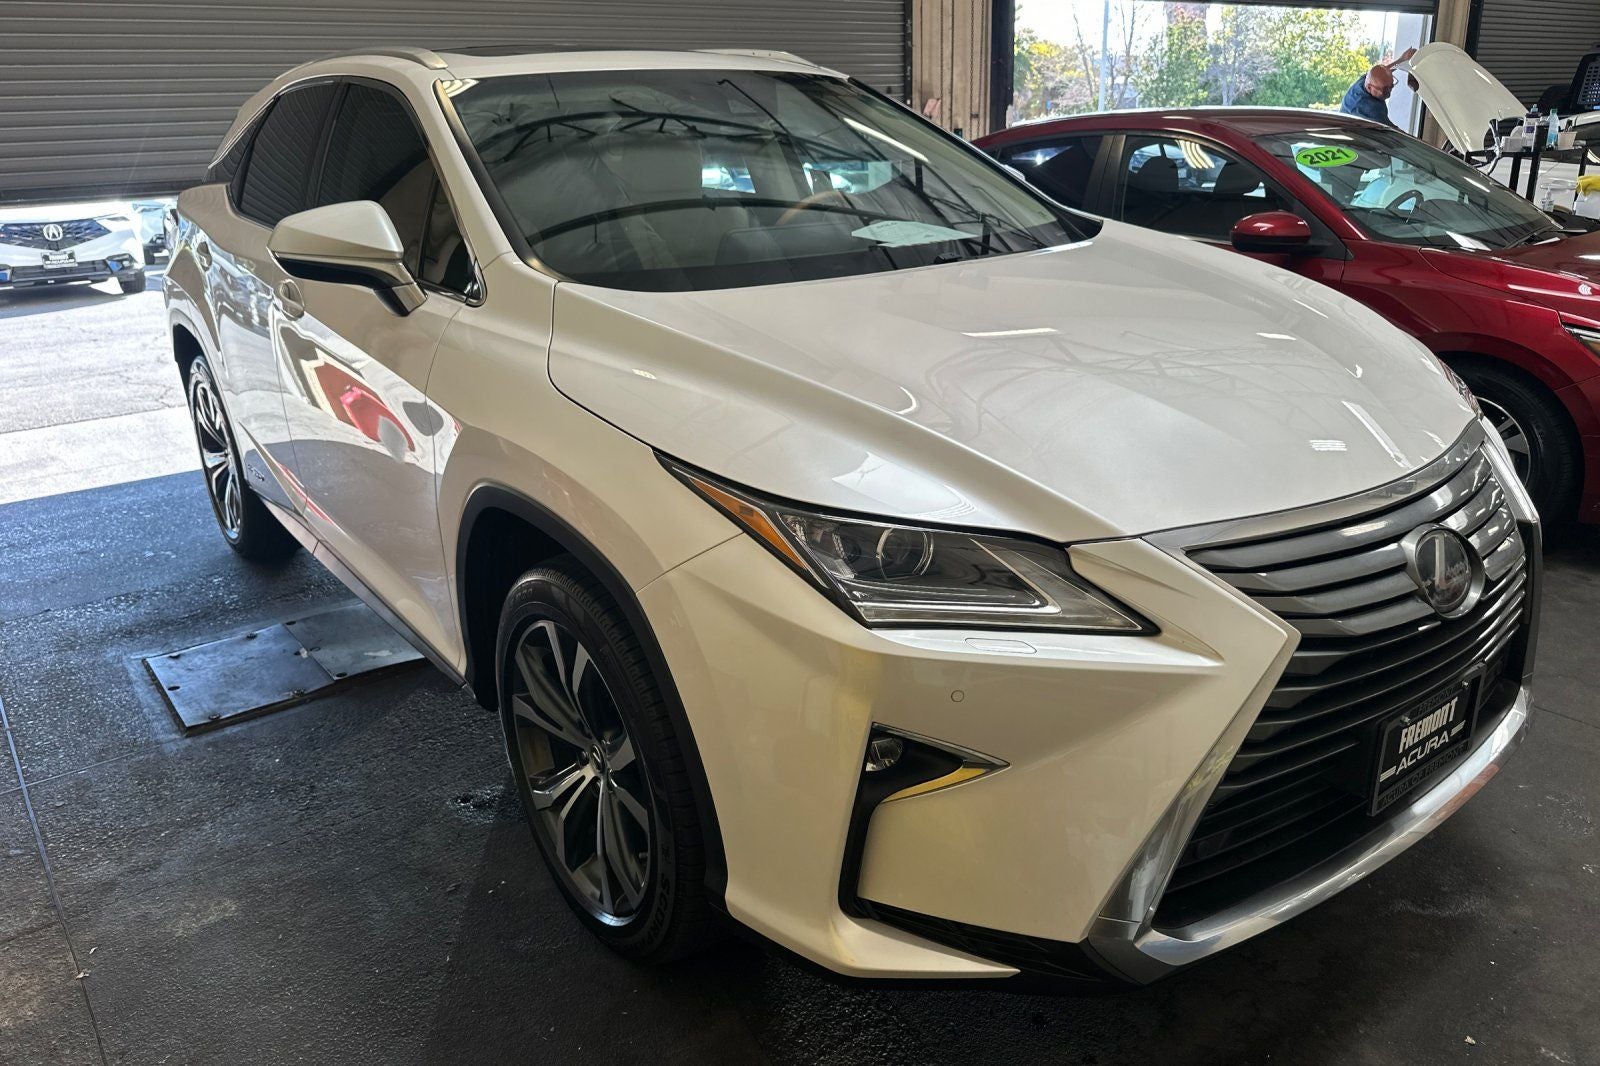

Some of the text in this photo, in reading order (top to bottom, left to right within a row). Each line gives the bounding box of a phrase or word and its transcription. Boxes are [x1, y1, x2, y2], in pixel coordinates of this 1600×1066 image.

[1303, 148, 1351, 165] 2021
[1399, 697, 1458, 754] FREMONT
[1396, 731, 1449, 775] ACURA
